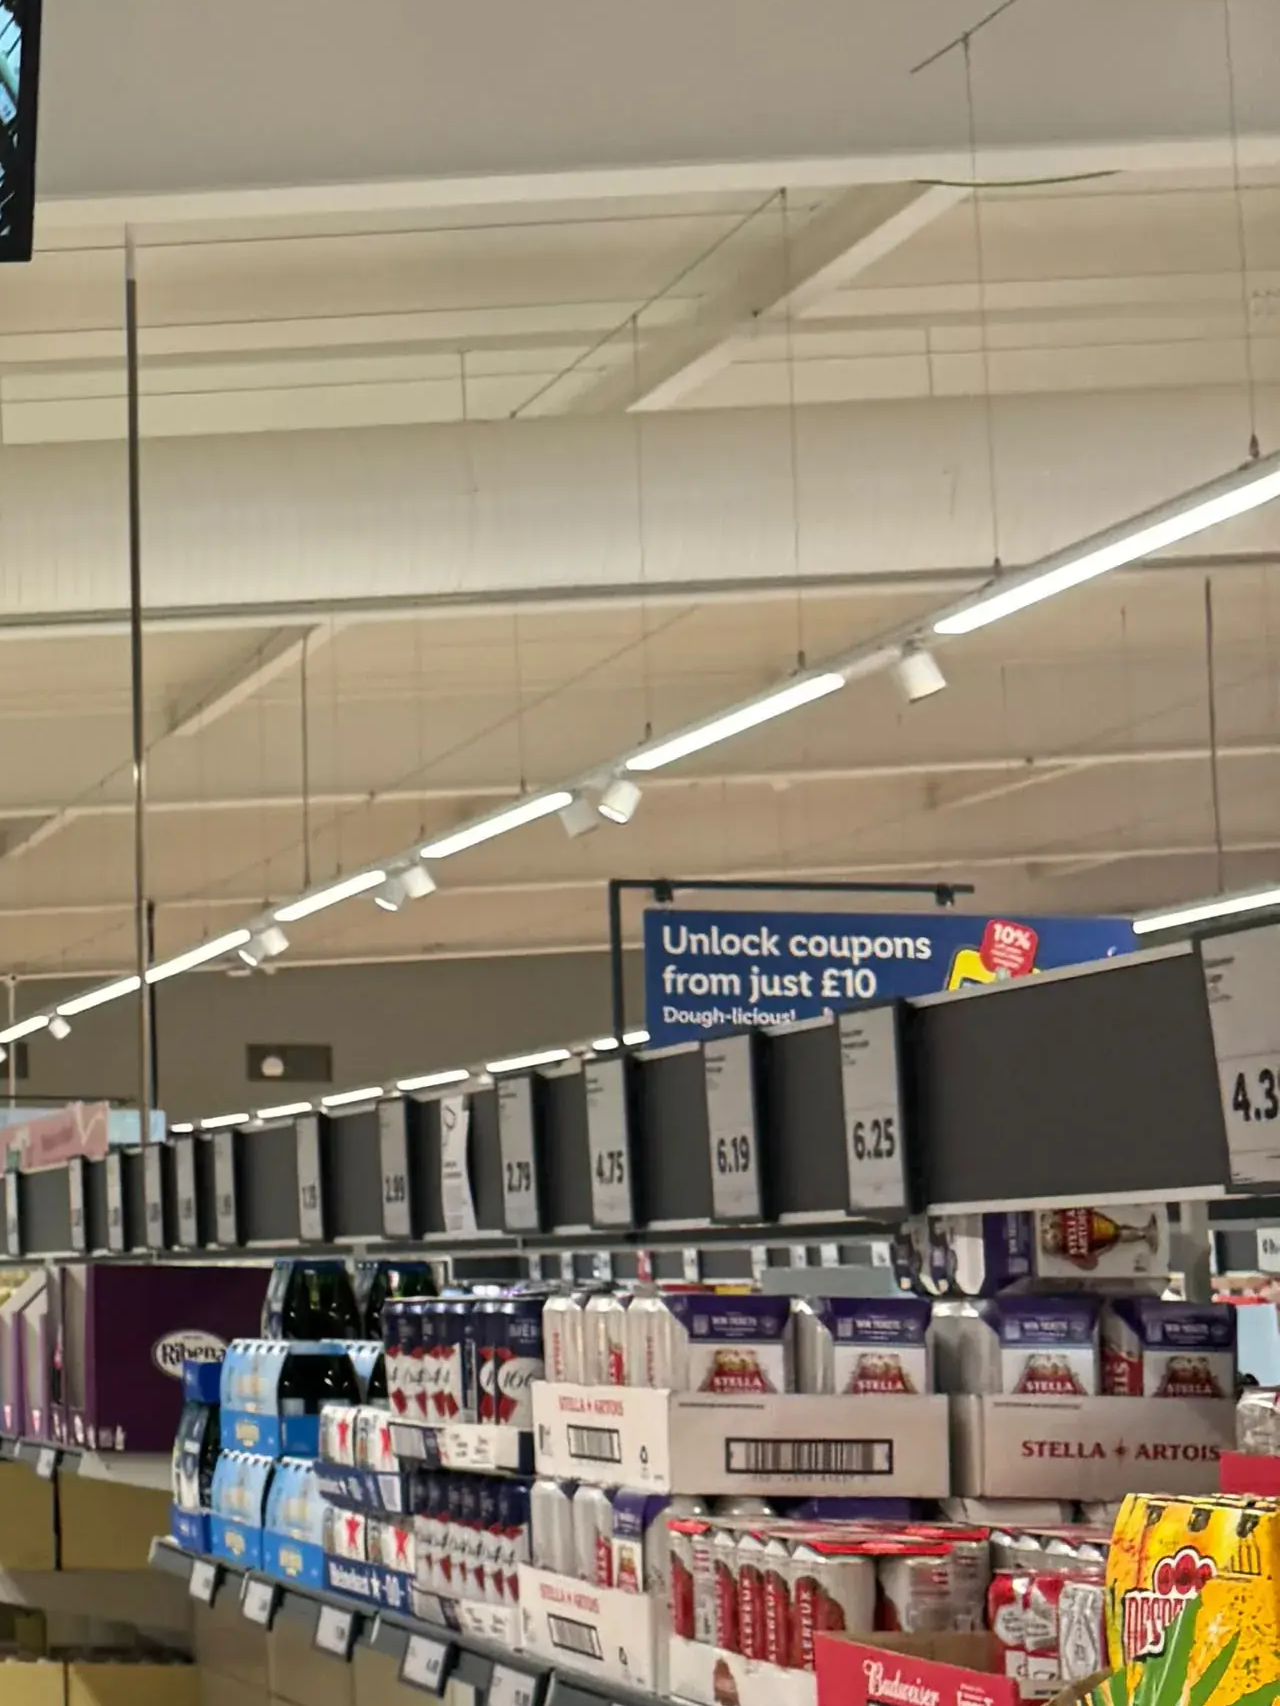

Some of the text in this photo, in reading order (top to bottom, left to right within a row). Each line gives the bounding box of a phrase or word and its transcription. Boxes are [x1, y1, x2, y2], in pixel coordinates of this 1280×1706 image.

[663, 924, 933, 966] Unlock coupons
[993, 923, 1032, 950] 10%
[662, 967, 878, 1002] from just £10
[1232, 1068, 1280, 1122] 4.3
[716, 1135, 750, 1174] 6.19
[852, 1117, 896, 1162] 6.25
[506, 1161, 531, 1193] 2.79
[595, 1150, 625, 1188] 4.75
[714, 1376, 762, 1387] STELLA
[857, 1379, 903, 1391] STELLA
[1018, 1380, 1067, 1392] STELLA
[1167, 1381, 1211, 1392] STELLA
[1021, 1440, 1221, 1462] STELLA ARTOIS
